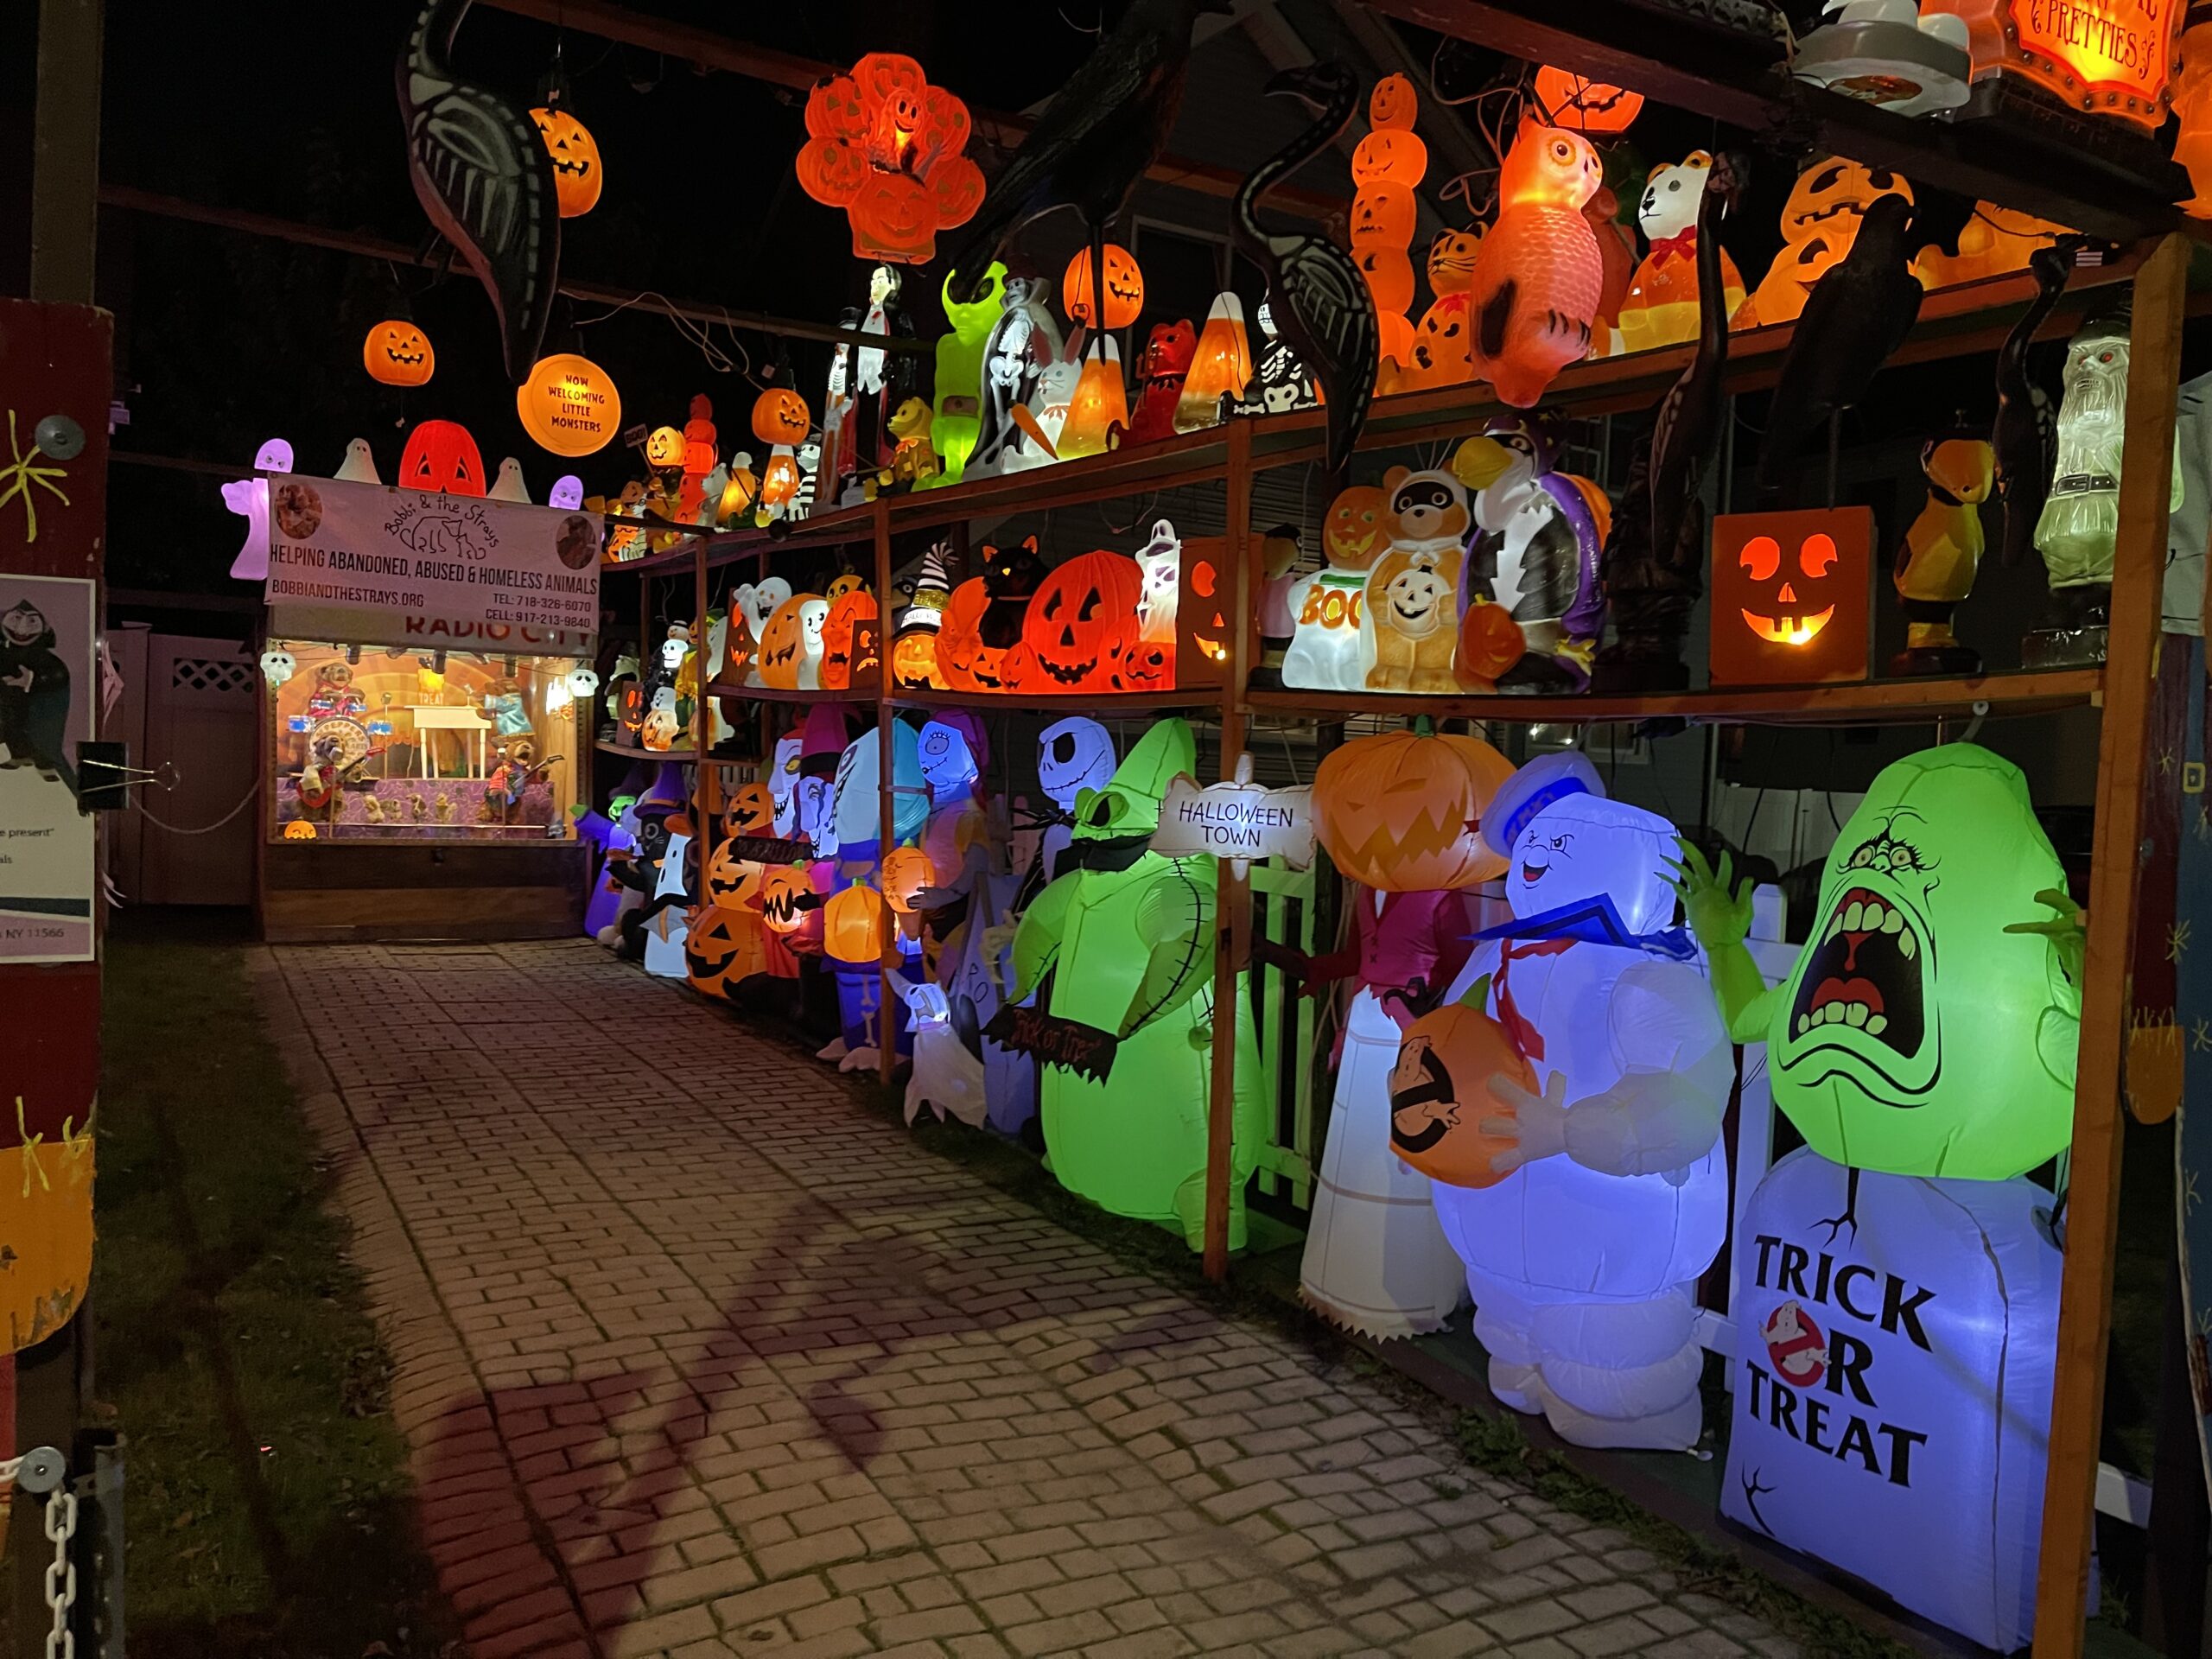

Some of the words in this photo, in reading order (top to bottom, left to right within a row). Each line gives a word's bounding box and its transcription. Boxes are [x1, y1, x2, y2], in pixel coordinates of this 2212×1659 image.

[2046, 0, 2137, 67] PRETTIES
[566, 375, 588, 387] NOW
[548, 386, 605, 404] WELCOMING
[562, 403, 591, 416] LITTLE
[551, 416, 601, 433] MONSTERS
[385, 503, 416, 536] Bobbi
[419, 494, 431, 509] &
[436, 496, 460, 513] the
[464, 505, 499, 548] Strays
[270, 543, 325, 568] HELPING
[328, 550, 411, 579] ABANDONED,
[415, 560, 465, 582] ABUSED
[467, 567, 476, 583] &
[479, 566, 543, 590] HOMELESS
[544, 574, 598, 595] ANIMALS
[272, 579, 424, 607] BOBBIANDTHESTRAYS.ORG
[493, 593, 515, 605] TEL:
[486, 608, 514, 620] CELL:
[1179, 801, 1294, 828] HALLOWEEN
[1201, 825, 1262, 848] TOWN
[6, 929, 24, 939] NY
[1754, 1234, 1937, 1353] TRICK
[1746, 1358, 1929, 1488] TREAT
